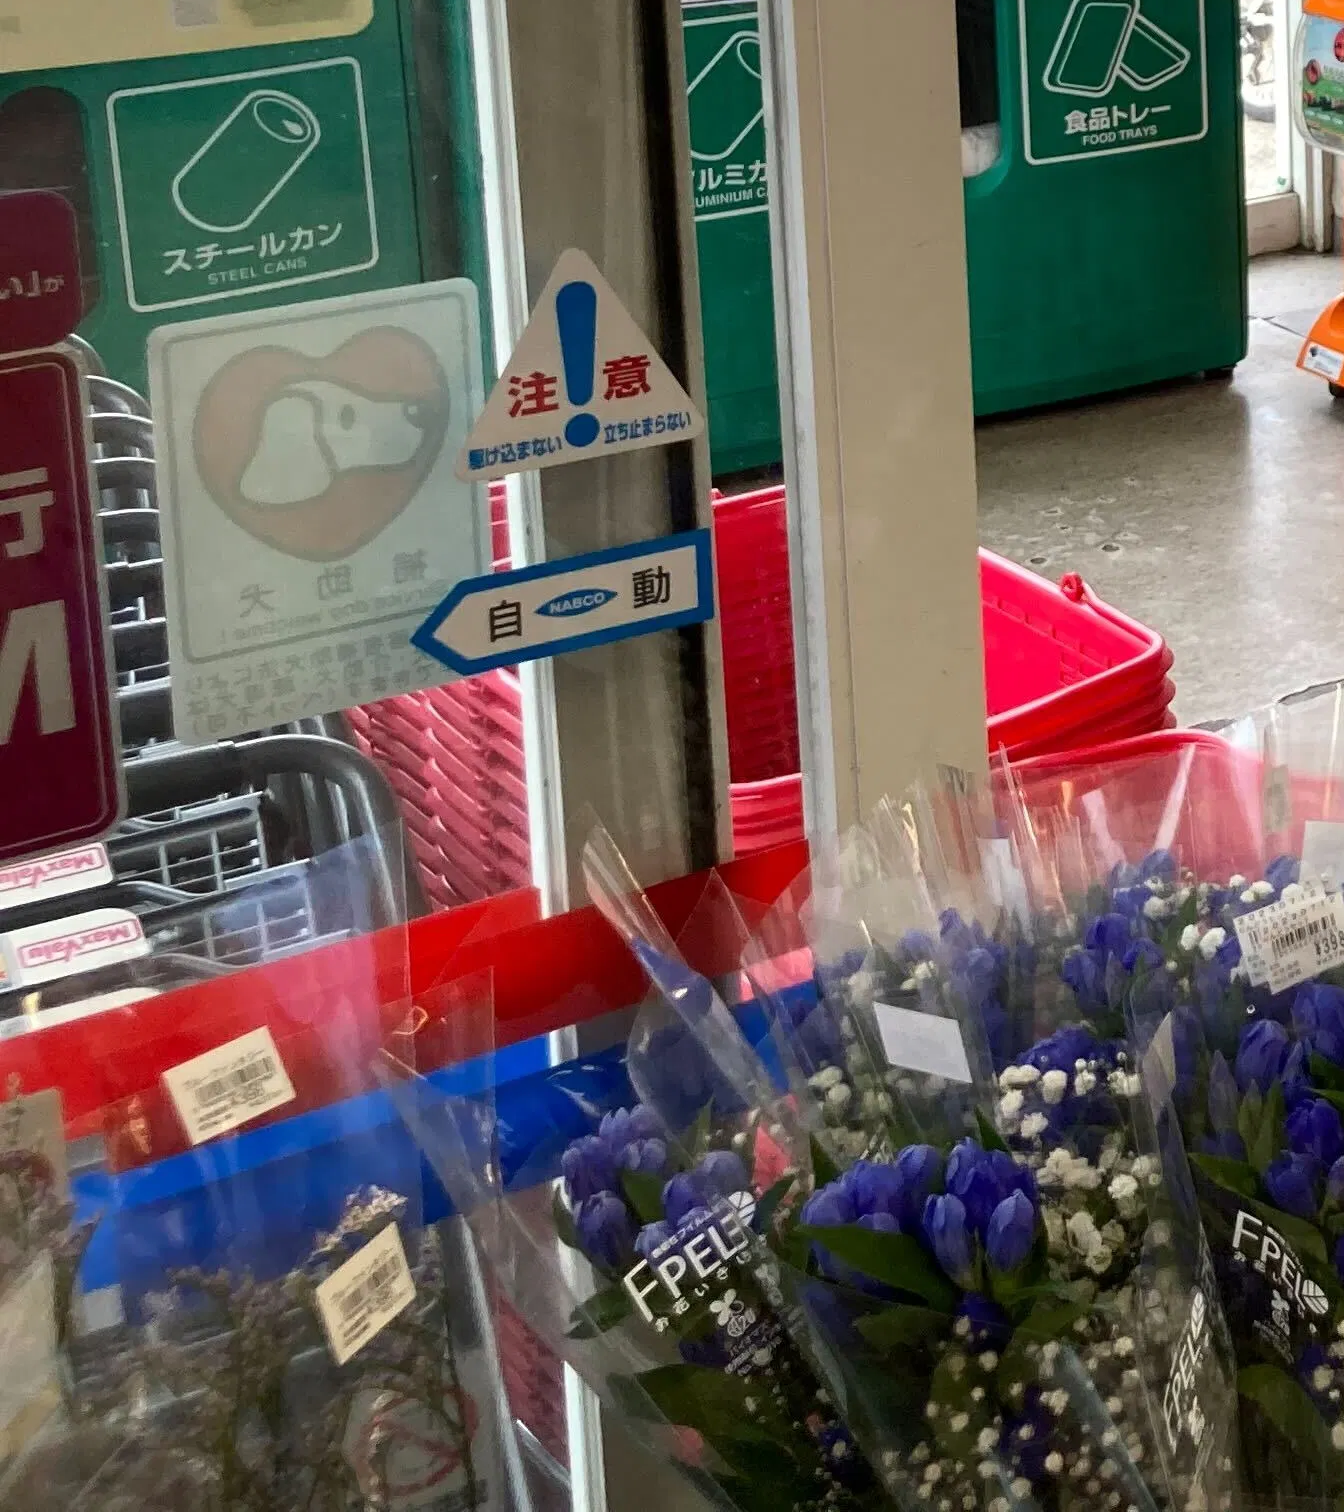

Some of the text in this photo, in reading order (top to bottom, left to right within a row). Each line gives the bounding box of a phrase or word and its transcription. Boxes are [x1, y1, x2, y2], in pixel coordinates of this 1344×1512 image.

[1063, 101, 1172, 136] 食品トレー
[1082, 125, 1158, 145] FOOD TRAYS
[162, 219, 344, 280] スチールカン
[207, 256, 308, 286] STEEL CANS
[604, 411, 691, 445] 立ち止まらない
[550, 592, 605, 613] NABCO
